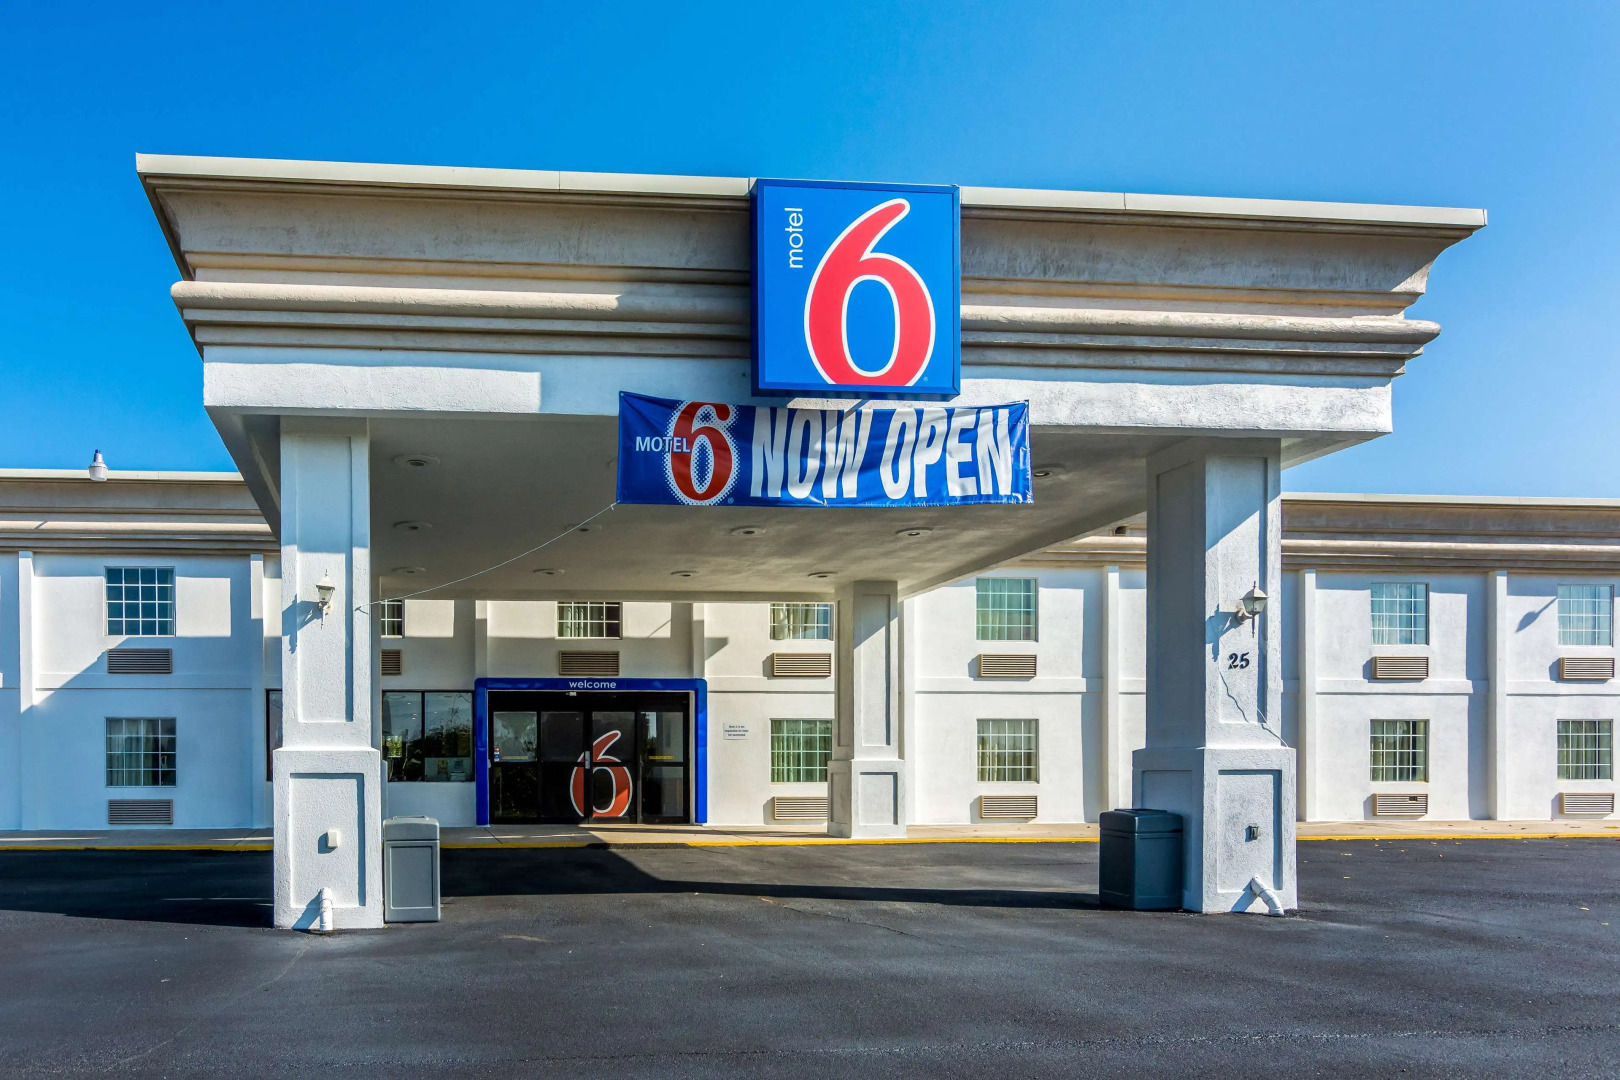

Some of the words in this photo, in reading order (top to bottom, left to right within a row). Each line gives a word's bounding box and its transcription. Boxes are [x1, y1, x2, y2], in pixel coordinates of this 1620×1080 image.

[784, 207, 804, 269] motel
[804, 198, 936, 387] 6
[635, 436, 691, 453] MOTEL
[668, 400, 735, 503] 6
[750, 405, 874, 499] NOW
[879, 407, 1013, 500] OPEN
[568, 679, 617, 689] welcome
[1228, 652, 1250, 670] 25
[569, 730, 633, 818] 6
